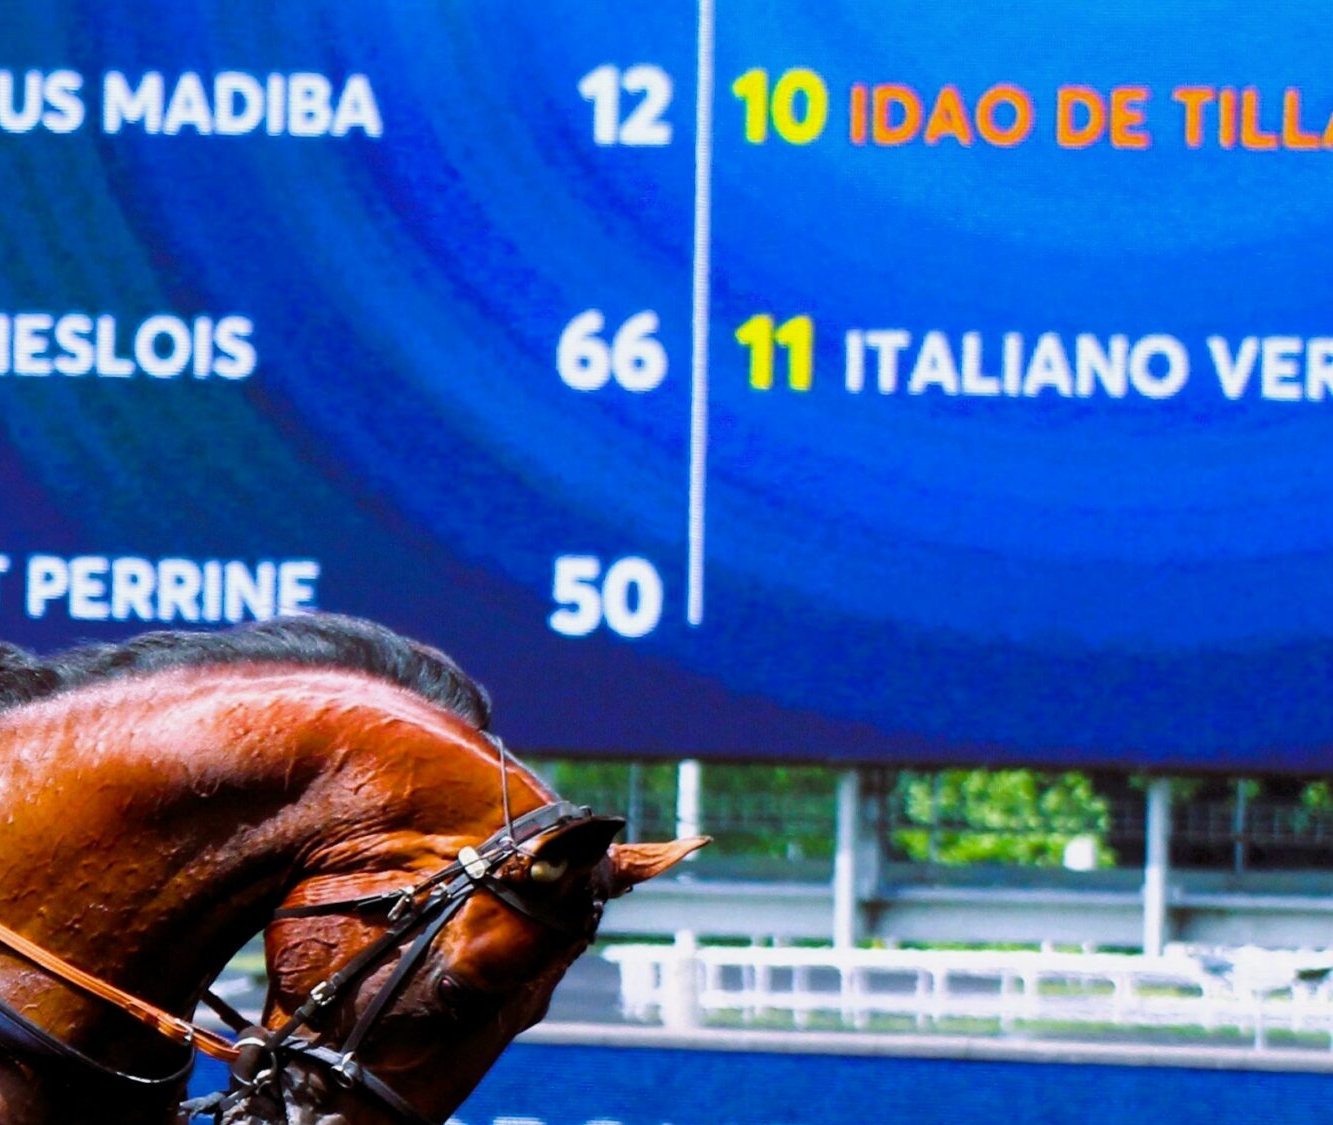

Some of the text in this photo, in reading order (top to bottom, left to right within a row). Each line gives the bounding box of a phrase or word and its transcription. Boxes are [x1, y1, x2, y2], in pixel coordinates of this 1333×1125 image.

[103, 71, 383, 138] MADIBA
[578, 65, 674, 147] 12
[732, 68, 1333, 150] 10 IDAO DE TILL
[556, 309, 668, 393] 66
[736, 314, 1333, 401] 11 ITALIANO VER
[27, 555, 321, 623] PERRINE
[549, 556, 663, 639] 50
